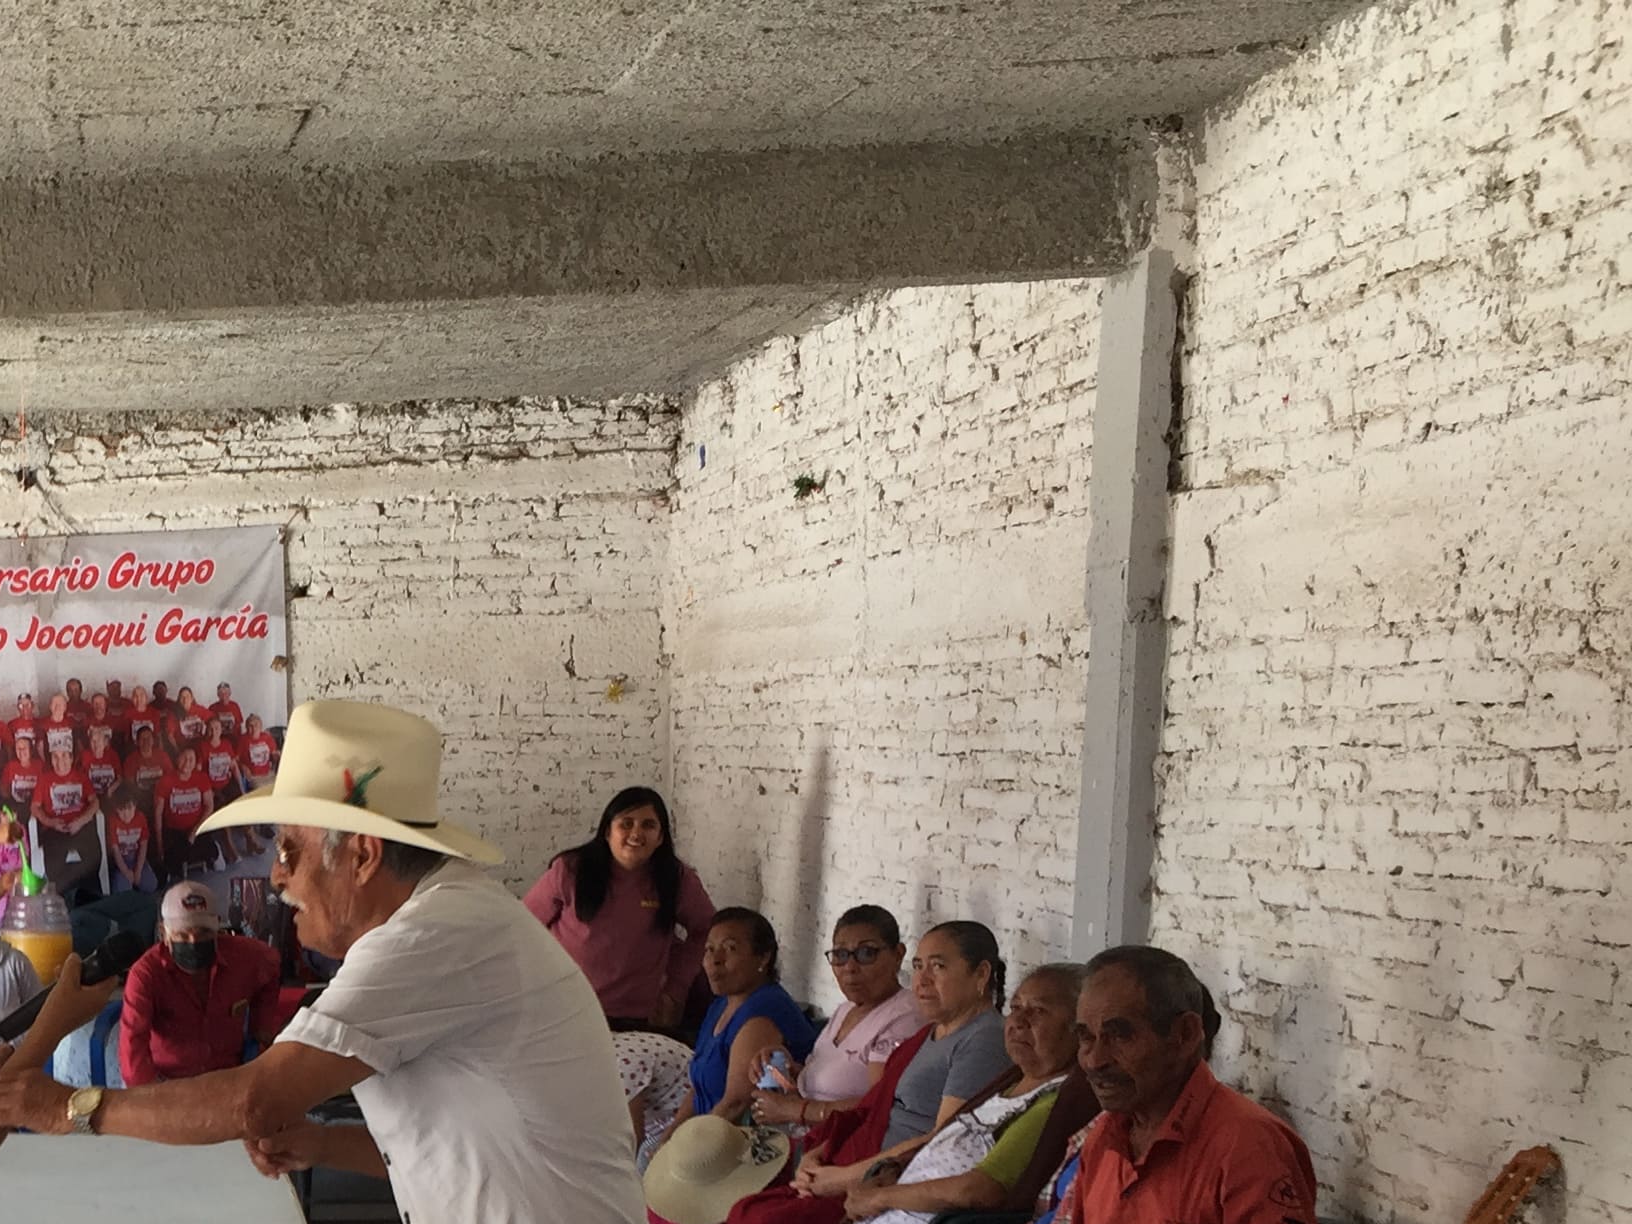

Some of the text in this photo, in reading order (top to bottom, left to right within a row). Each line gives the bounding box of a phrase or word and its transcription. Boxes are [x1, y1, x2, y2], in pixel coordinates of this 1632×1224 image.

[107, 551, 216, 594] Grupo
[15, 611, 148, 656] Jocoqui
[154, 604, 269, 646] García
